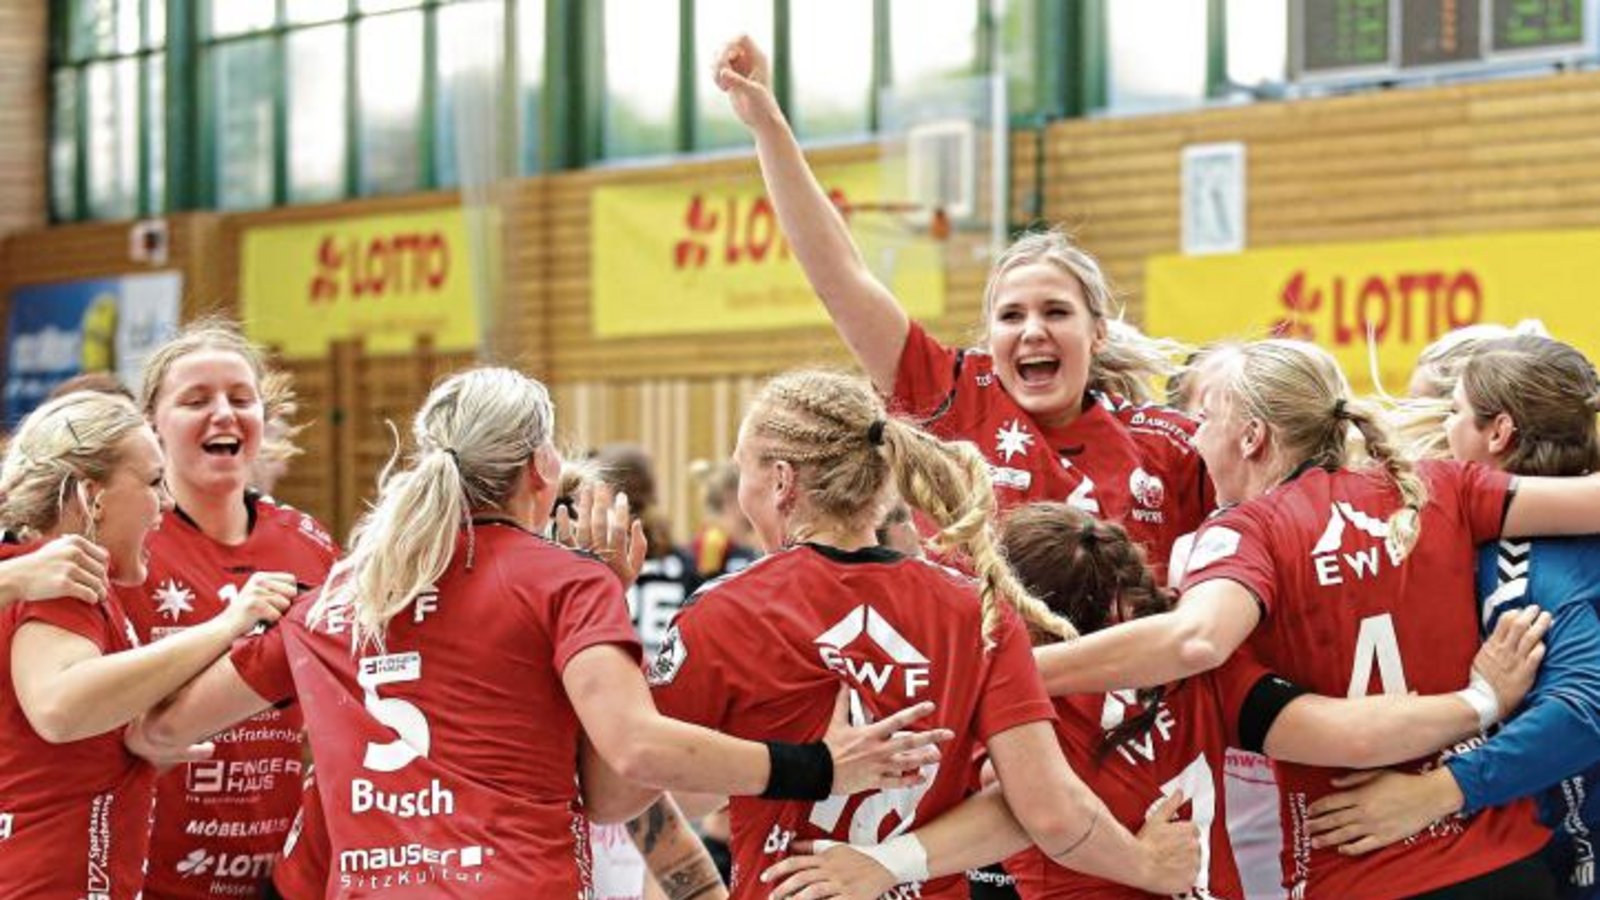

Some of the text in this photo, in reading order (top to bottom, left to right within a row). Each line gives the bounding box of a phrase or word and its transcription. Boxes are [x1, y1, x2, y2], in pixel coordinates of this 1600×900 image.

[351, 230, 449, 298] LOTTO
[1332, 270, 1483, 346] LOTTO
[356, 650, 431, 772] 5
[350, 778, 455, 818] Busch
[213, 852, 281, 878] LOTT
[339, 843, 457, 873] mauser
